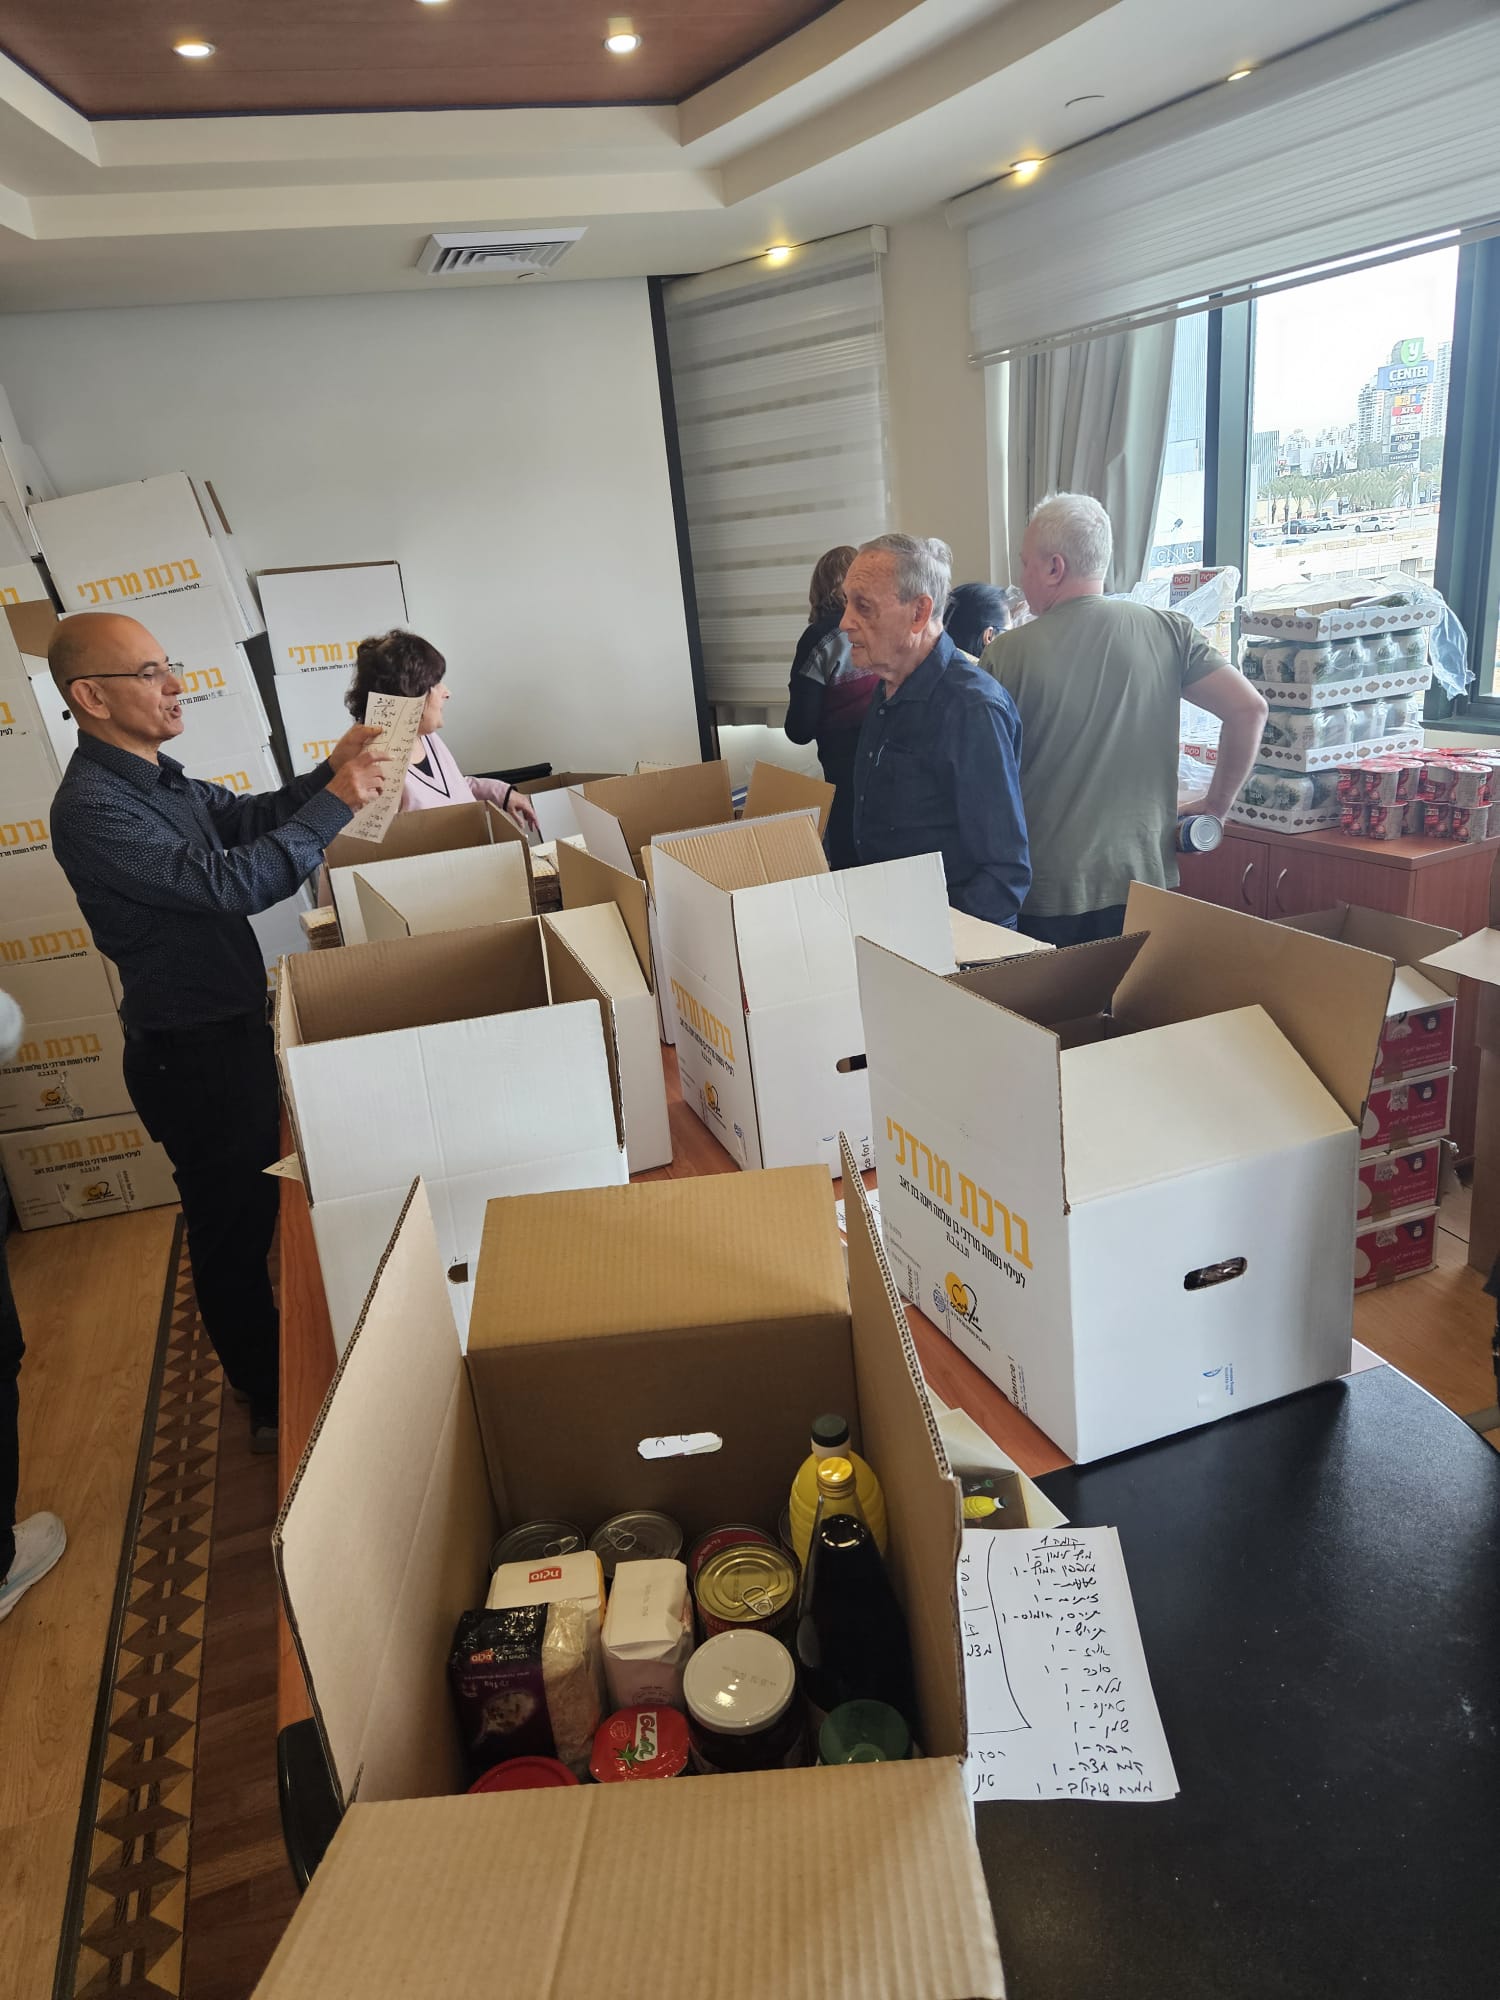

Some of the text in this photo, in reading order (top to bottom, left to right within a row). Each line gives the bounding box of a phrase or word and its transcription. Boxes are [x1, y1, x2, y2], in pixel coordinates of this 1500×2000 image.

[1389, 366, 1429, 382] CENTER
[76, 558, 201, 604] ברכת מרדכי
[288, 643, 343, 666] מרדכי
[206, 770, 252, 792] בר
[29, 927, 90, 957] ברכת
[701, 1003, 736, 1064] ברכת
[43, 1033, 103, 1059] ברכת
[18, 1128, 144, 1167] ברכת מרדכי
[886, 1115, 953, 1206] מרדכי
[933, 1203, 952, 1228] שלמה
[953, 1219, 960, 1235] בן
[958, 1171, 1034, 1271] ברכת
[960, 1226, 981, 1252] מרדכי
[981, 1243, 1002, 1270] נשמת
[1003, 1260, 1026, 1288] לעילוי
[1053, 1537, 1079, 1550] קומה
[1046, 1550, 1071, 1563] לימון
[1073, 1551, 1092, 1561] מיץ
[531, 1569, 560, 1582] סוגת
[1083, 1663, 1111, 1676] סוכר
[1096, 1677, 1122, 1694] מלח
[1093, 1699, 1126, 1718] טחינה
[1105, 1719, 1129, 1739] שמן
